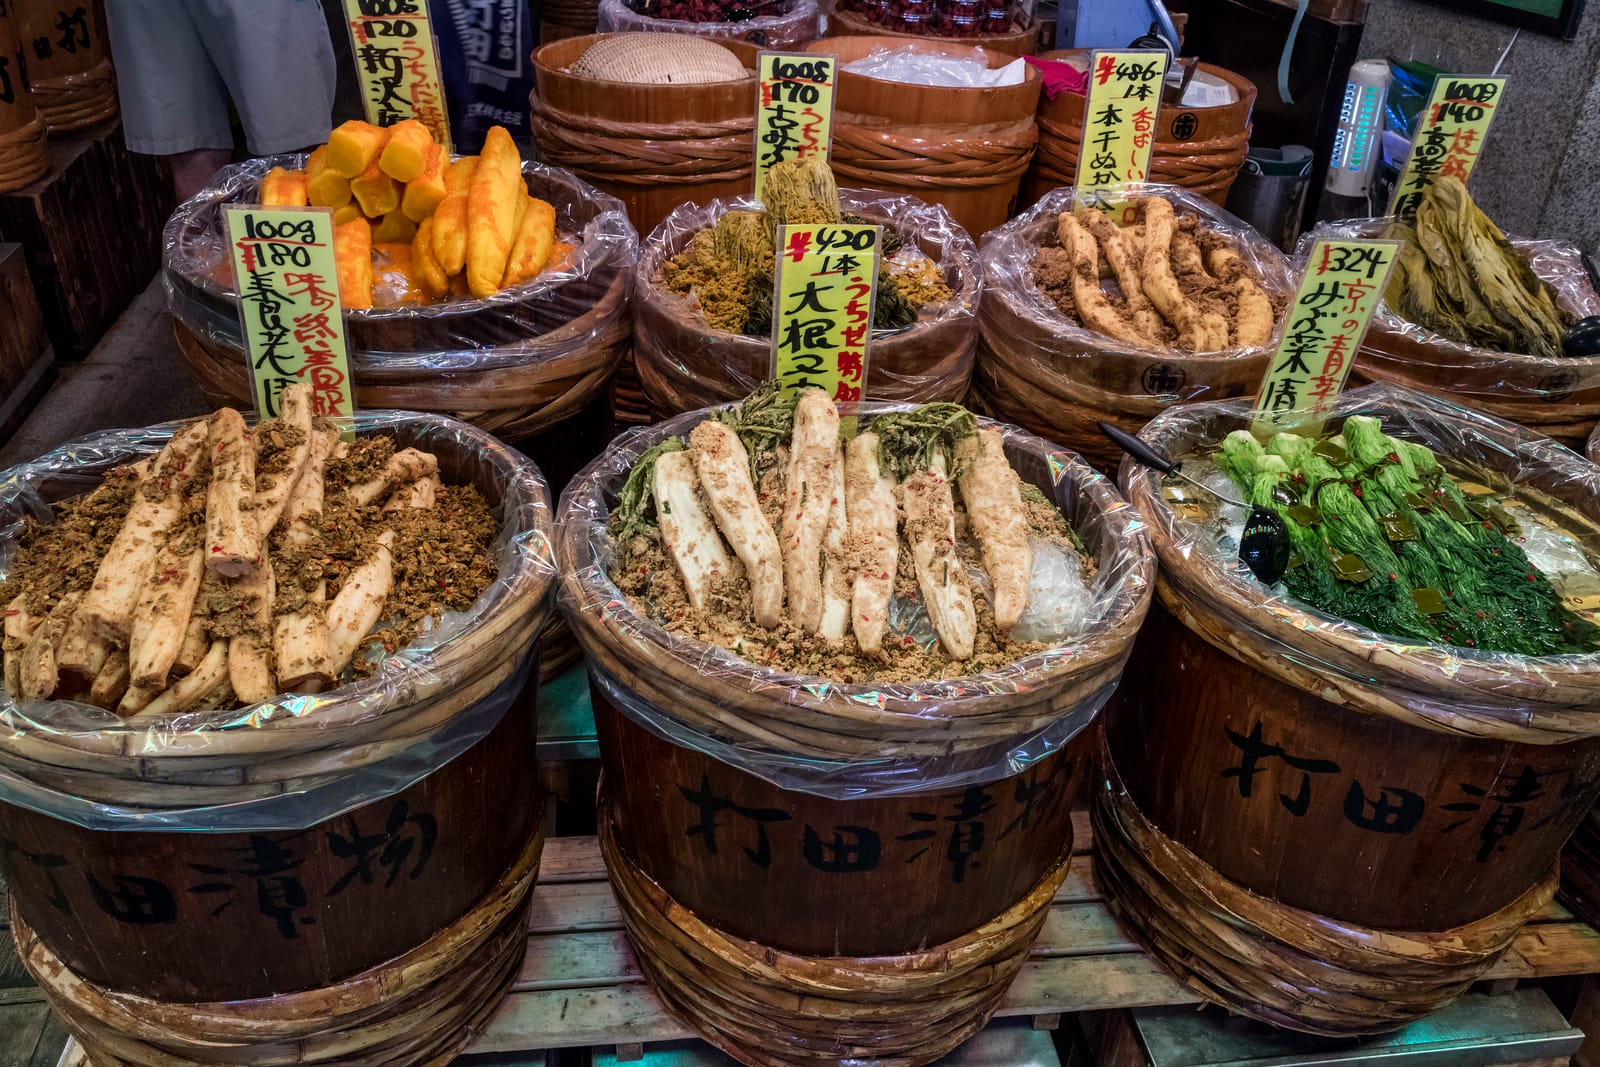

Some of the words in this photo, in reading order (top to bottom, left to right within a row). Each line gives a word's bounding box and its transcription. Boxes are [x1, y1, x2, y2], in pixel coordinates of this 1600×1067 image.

[771, 57, 830, 83] 100g
[760, 80, 820, 107] ¥170
[1428, 102, 1484, 127] ¥140
[244, 214, 316, 244] 100g
[236, 242, 311, 272] ¥180
[785, 227, 876, 263] ¥420
[820, 254, 861, 276] 1本
[1317, 244, 1388, 278] ¥324
